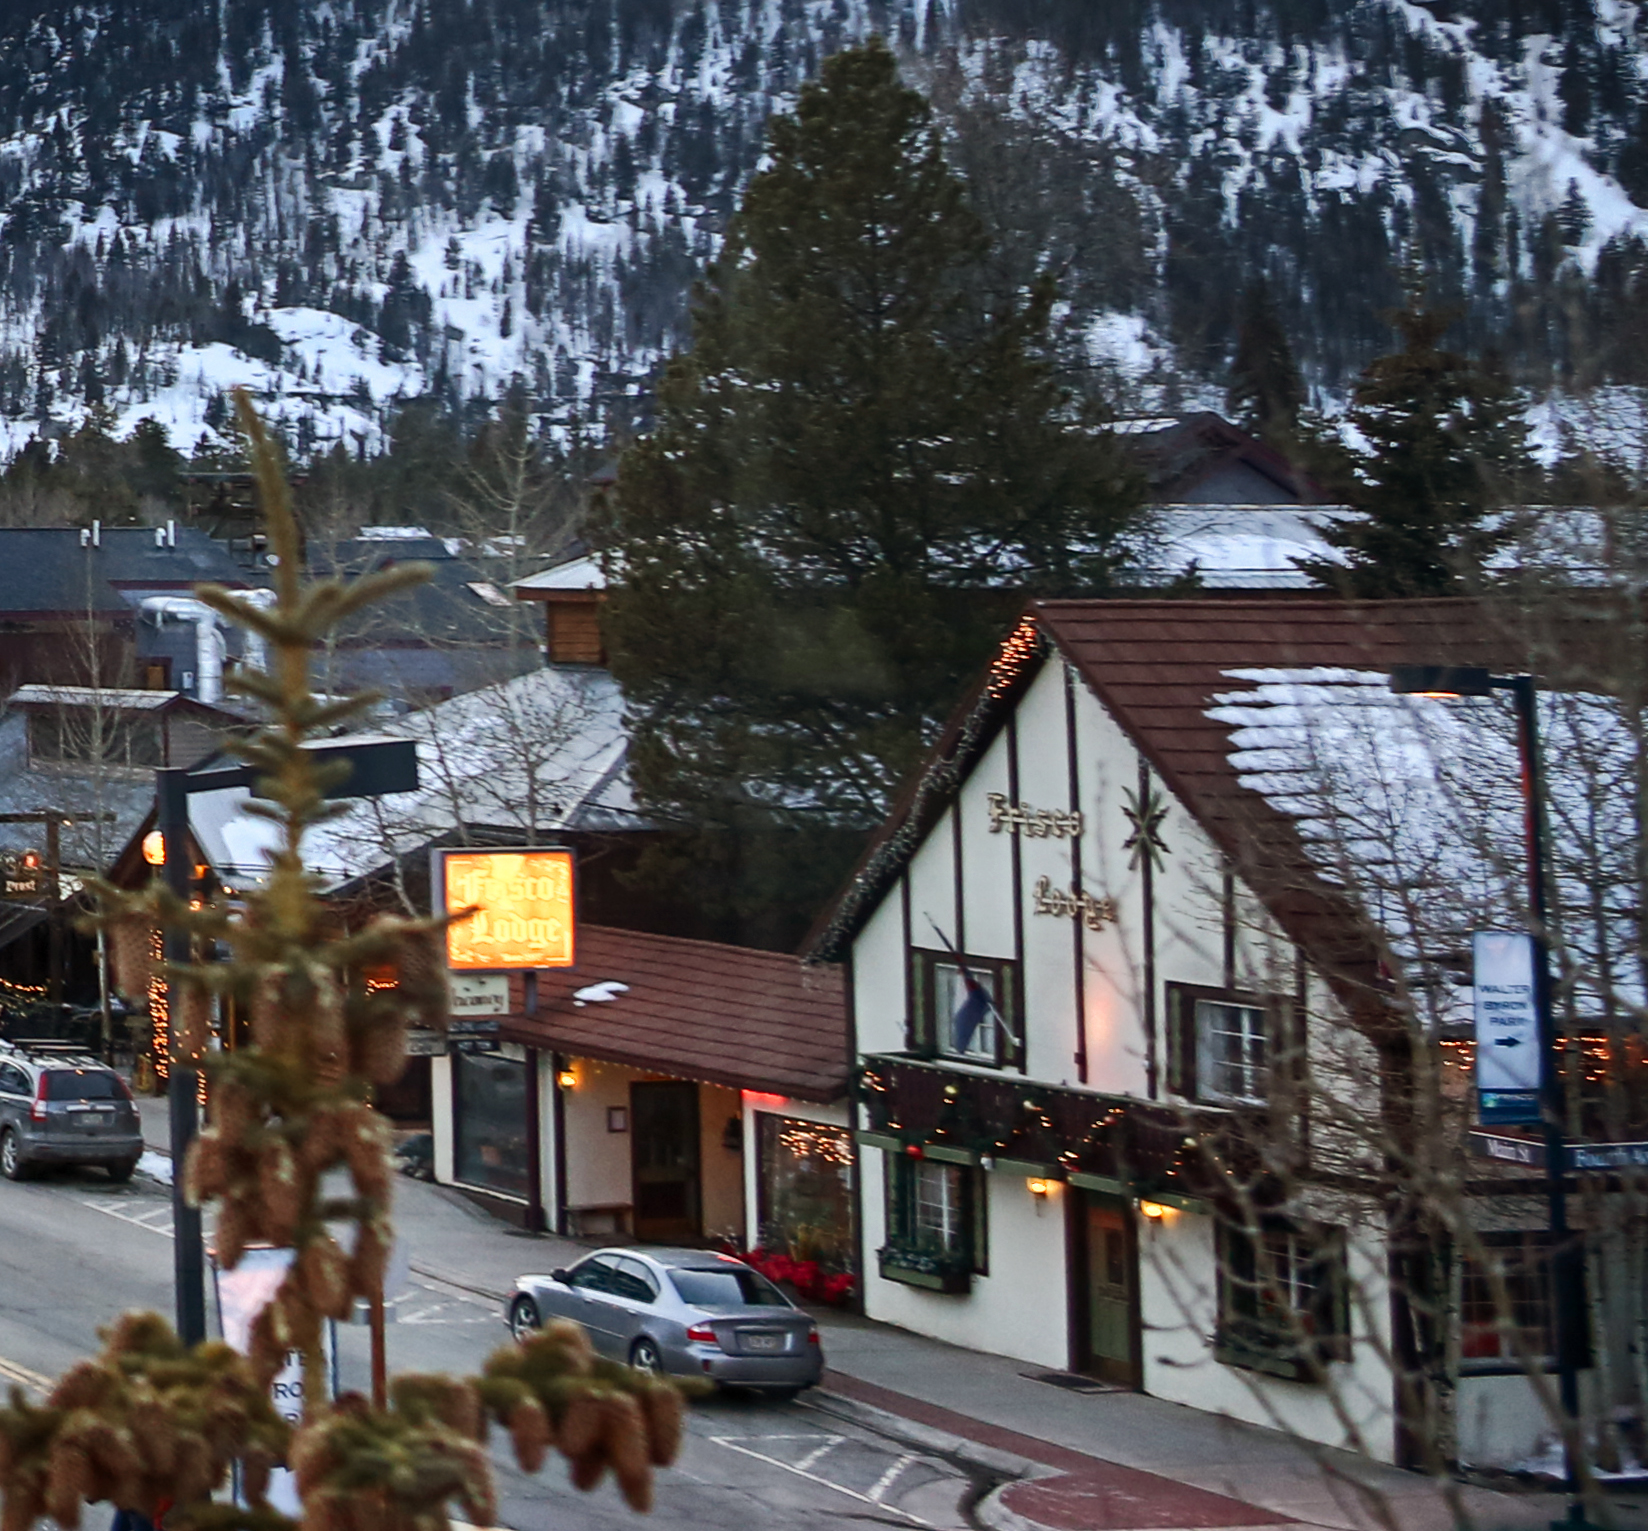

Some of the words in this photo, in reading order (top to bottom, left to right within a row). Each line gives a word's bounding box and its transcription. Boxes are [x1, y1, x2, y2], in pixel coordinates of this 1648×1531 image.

[987, 792, 1085, 838] Frisco
[456, 869, 555, 904] Frisco
[1033, 875, 1118, 931] Lodge
[469, 910, 561, 949] Lodge
[1479, 984, 1531, 995] WALTER
[1488, 1016, 1527, 1026] PARK
